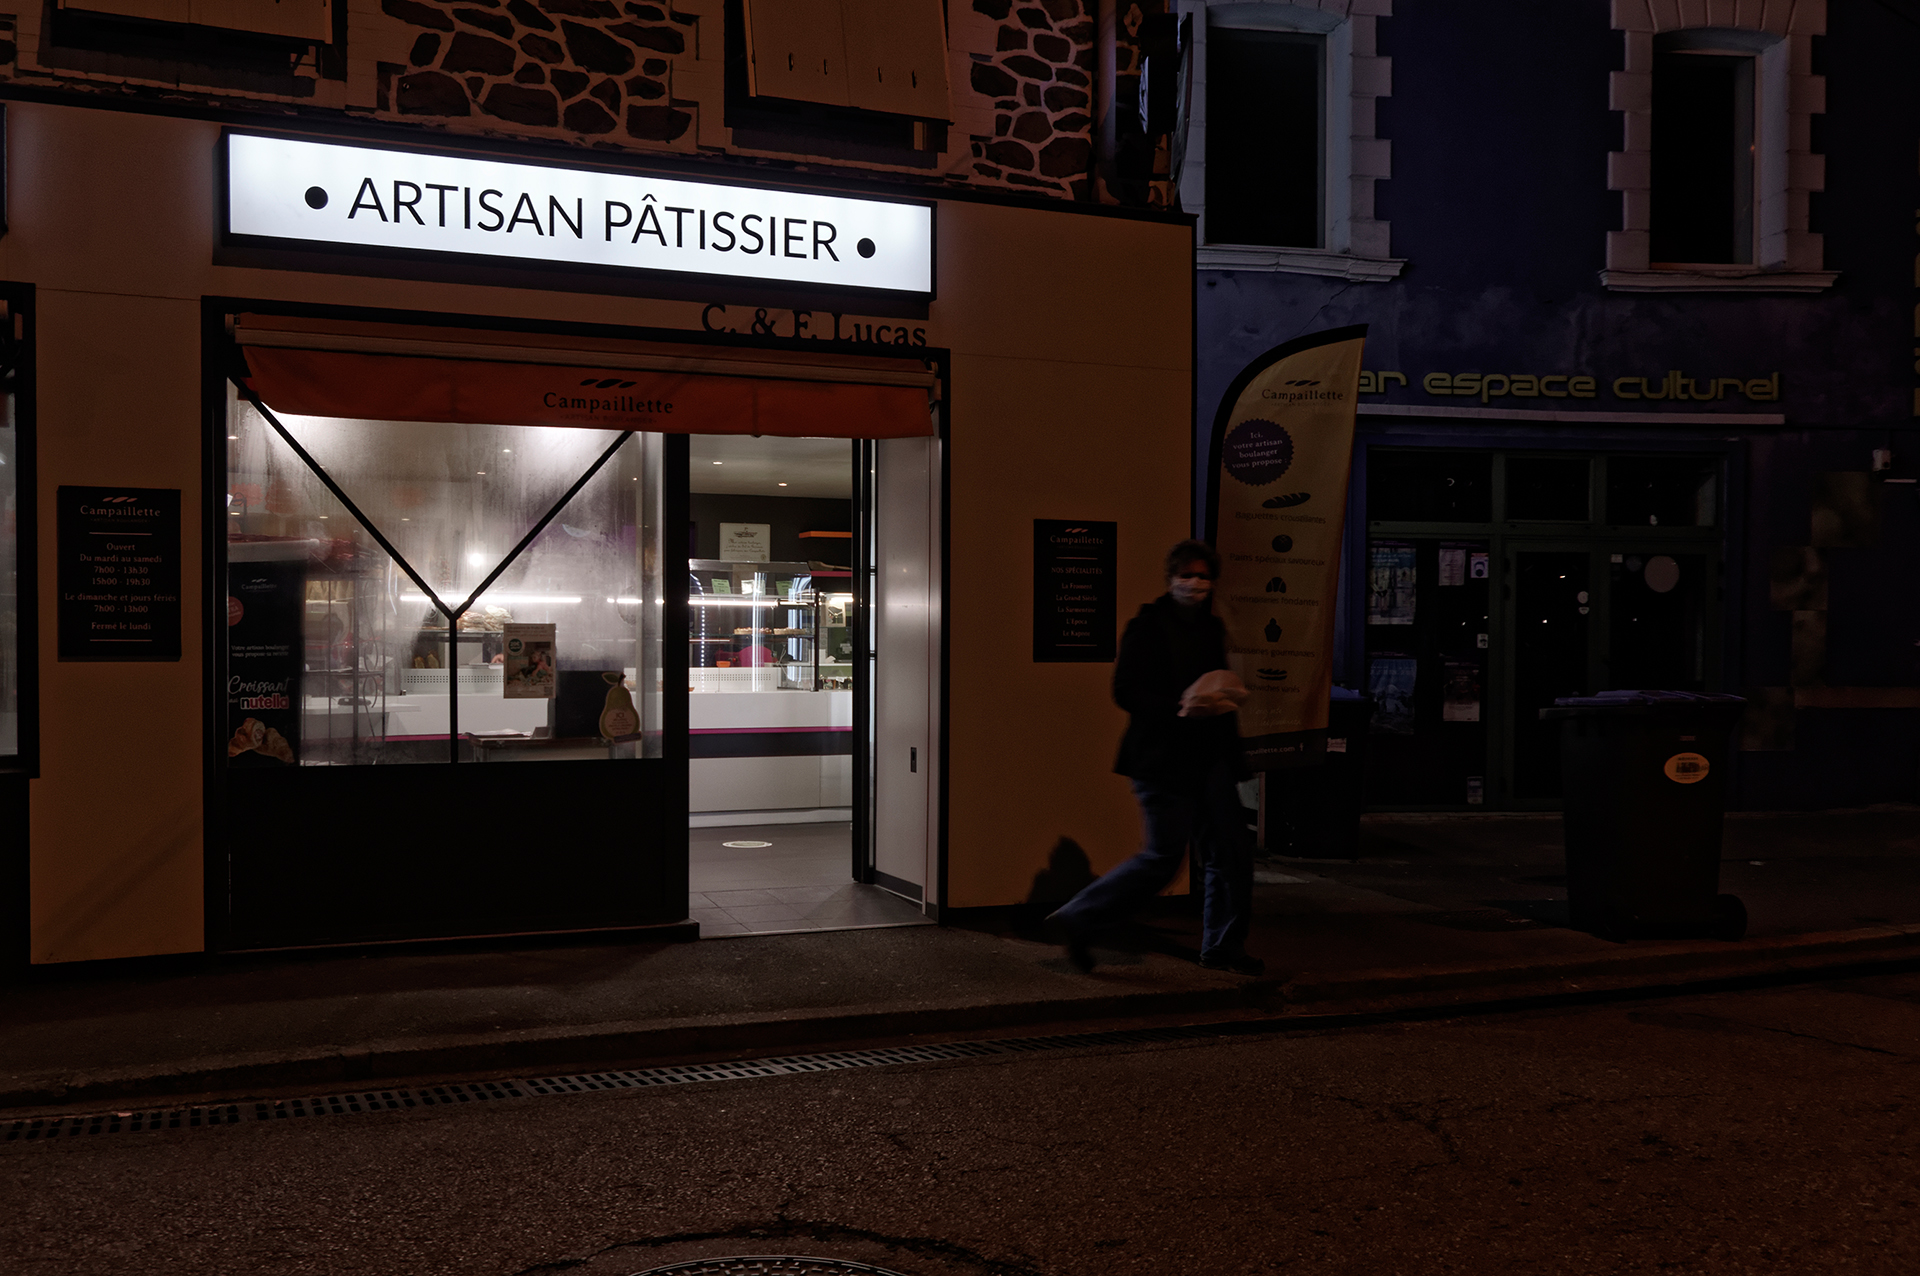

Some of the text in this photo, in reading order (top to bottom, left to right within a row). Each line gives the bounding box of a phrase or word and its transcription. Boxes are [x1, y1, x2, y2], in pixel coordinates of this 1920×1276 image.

[347, 177, 840, 262] ARTISAN PÂTISSIER
[702, 303, 737, 334] C.
[751, 308, 776, 337] &
[832, 312, 927, 348] Lucas
[1423, 371, 1597, 404] espace
[1612, 369, 1780, 401] culturel
[1261, 388, 1344, 402] Campaillette
[543, 391, 673, 414] Campaillette
[1232, 438, 1283, 450] votre artisan
[1239, 448, 1278, 459] boulanger
[1251, 458, 1282, 469] propose
[80, 505, 161, 518] Campaillette
[1235, 511, 1279, 522] Baguettes
[1050, 535, 1104, 545] Campaillette
[106, 542, 136, 551] Ouvert
[80, 553, 163, 563] Du mardi au samedi
[1229, 552, 1253, 562] Pains
[1255, 553, 1286, 565] spéciaux
[94, 565, 115, 574] 7h00
[123, 566, 149, 575] 13h30
[1051, 565, 1103, 575] NOS SPÉCIALITÉS
[92, 577, 118, 586] 15h00
[125, 577, 151, 586] 19h30
[1061, 582, 1069, 590] La
[64, 592, 177, 603] Le dimanche et jours fériés
[1281, 596, 1319, 607] fondantes
[94, 604, 115, 613] 7h00
[123, 605, 149, 614] 13h00
[91, 621, 152, 631] Fermé le lundi
[228, 675, 294, 695] Croissant
[240, 693, 290, 710] nutella
